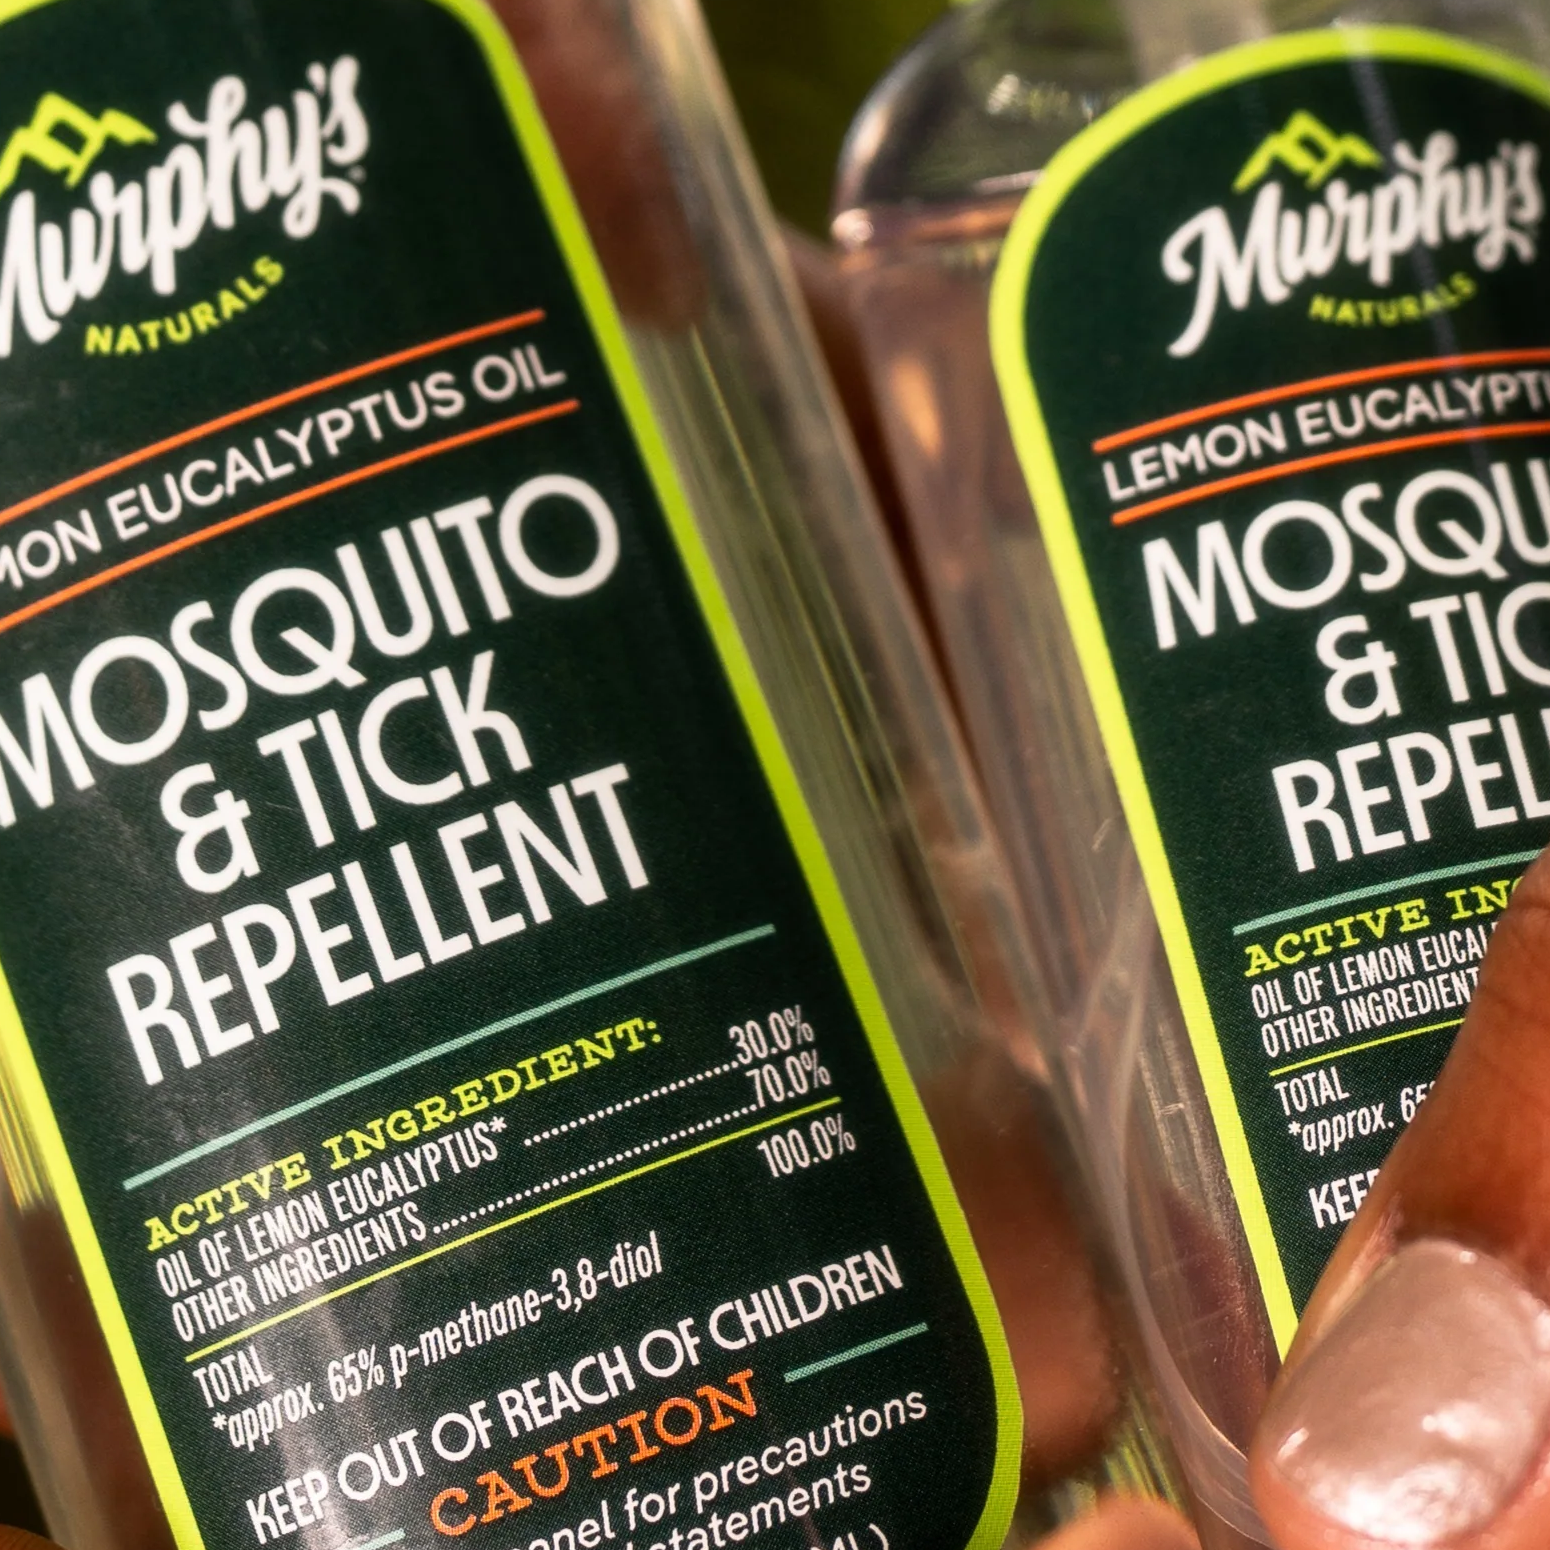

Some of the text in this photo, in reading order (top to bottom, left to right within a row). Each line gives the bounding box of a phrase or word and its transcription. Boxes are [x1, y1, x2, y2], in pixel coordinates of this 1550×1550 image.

[84, 255, 285, 355] NATURALS
[1161, 131, 1545, 357] Murphy's
[1308, 271, 1477, 328] NATURALS
[105, 371, 466, 541] EUCALYPTUS
[471, 342, 567, 403] OIL
[1102, 411, 1287, 502] LEMON
[1315, 614, 1399, 727] &
[160, 651, 534, 895] & TICK
[106, 764, 651, 1087] REPELLENT
[1243, 898, 1431, 978] ACTIVE
[1250, 978, 1292, 1020] OIL
[1293, 966, 1325, 1006] OF
[1329, 943, 1416, 997] LEMON
[1260, 966, 1480, 1059] OTHER INGREDIENT
[1274, 1066, 1350, 1117] TOTAL
[144, 1016, 662, 1251] ACTIVE INGREDIENT:
[155, 1248, 203, 1298] OIL
[198, 1230, 233, 1278] OF
[234, 1190, 330, 1263] LEMON
[728, 1004, 815, 1065] 30.0%
[171, 1049, 832, 1343] OTHER INGREDIENTS 70.0%
[192, 1113, 857, 1408] TOTAL 100.0%
[327, 1344, 385, 1404] 65%
[389, 1230, 663, 1389] p-methane-3,8-diol
[246, 1245, 904, 1545] KEEP OUT OF REACH OF CHILDREN
[430, 1368, 757, 1536] CAUTION
[624, 1482, 681, 1531] for
[693, 1391, 928, 1514] precautions
